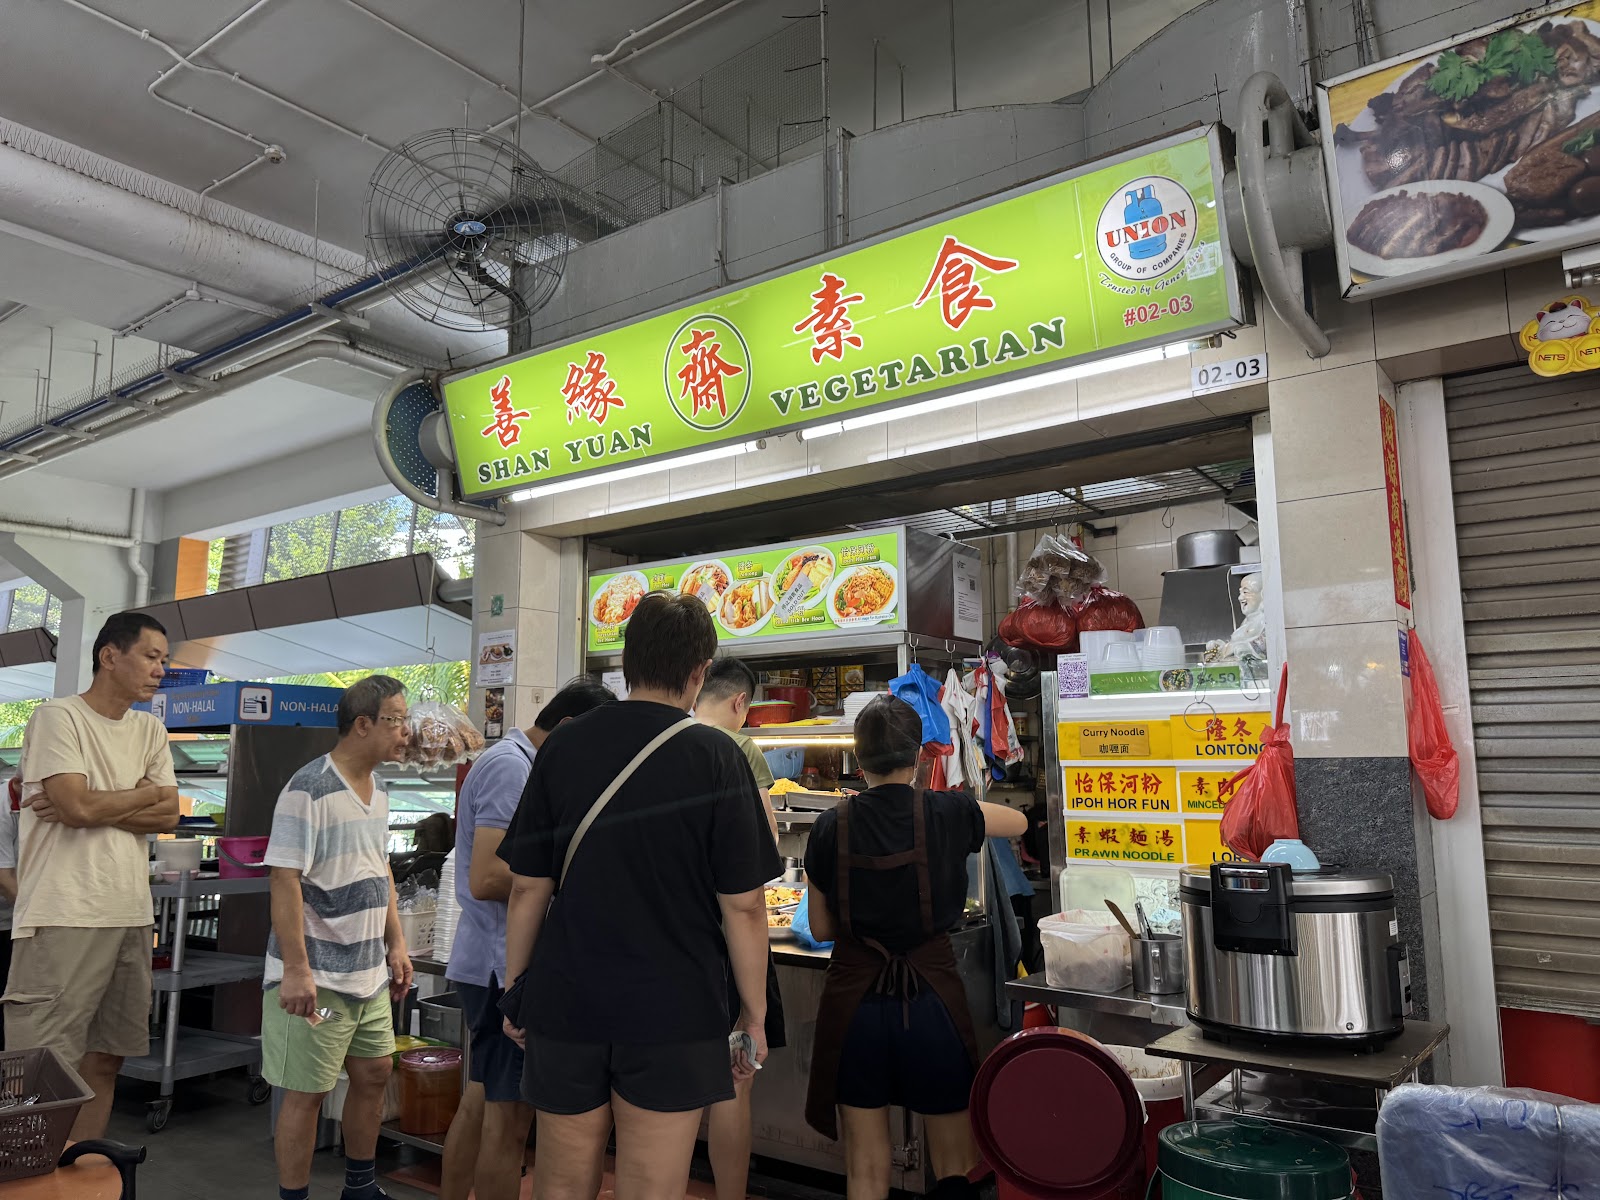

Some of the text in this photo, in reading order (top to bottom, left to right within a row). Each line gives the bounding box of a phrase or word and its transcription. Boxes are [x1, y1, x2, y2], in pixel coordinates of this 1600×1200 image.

[1105, 209, 1187, 248] UNION
[1110, 232, 1187, 274] GROUP OF COMPANIES
[1099, 272, 1136, 295] Trusted
[1140, 284, 1151, 295] by
[1123, 295, 1193, 326] #02-03
[1538, 353, 1566, 361] NETS
[1580, 346, 1600, 357] NET
[1198, 358, 1260, 386] 02-03
[479, 318, 1065, 484] SHAN YUAN VEGETARIAN
[797, 590, 805, 601] OUT
[172, 699, 216, 714] NON-HALAL
[280, 700, 339, 713] NON-HALA
[1082, 727, 1145, 738] Curry Noodle
[1205, 717, 1252, 743] 隆冬
[1075, 771, 1162, 795] 怡保河粉
[1072, 797, 1170, 811] IPOH HOR FUN
[1074, 848, 1175, 861] PRAWN NOODLE
